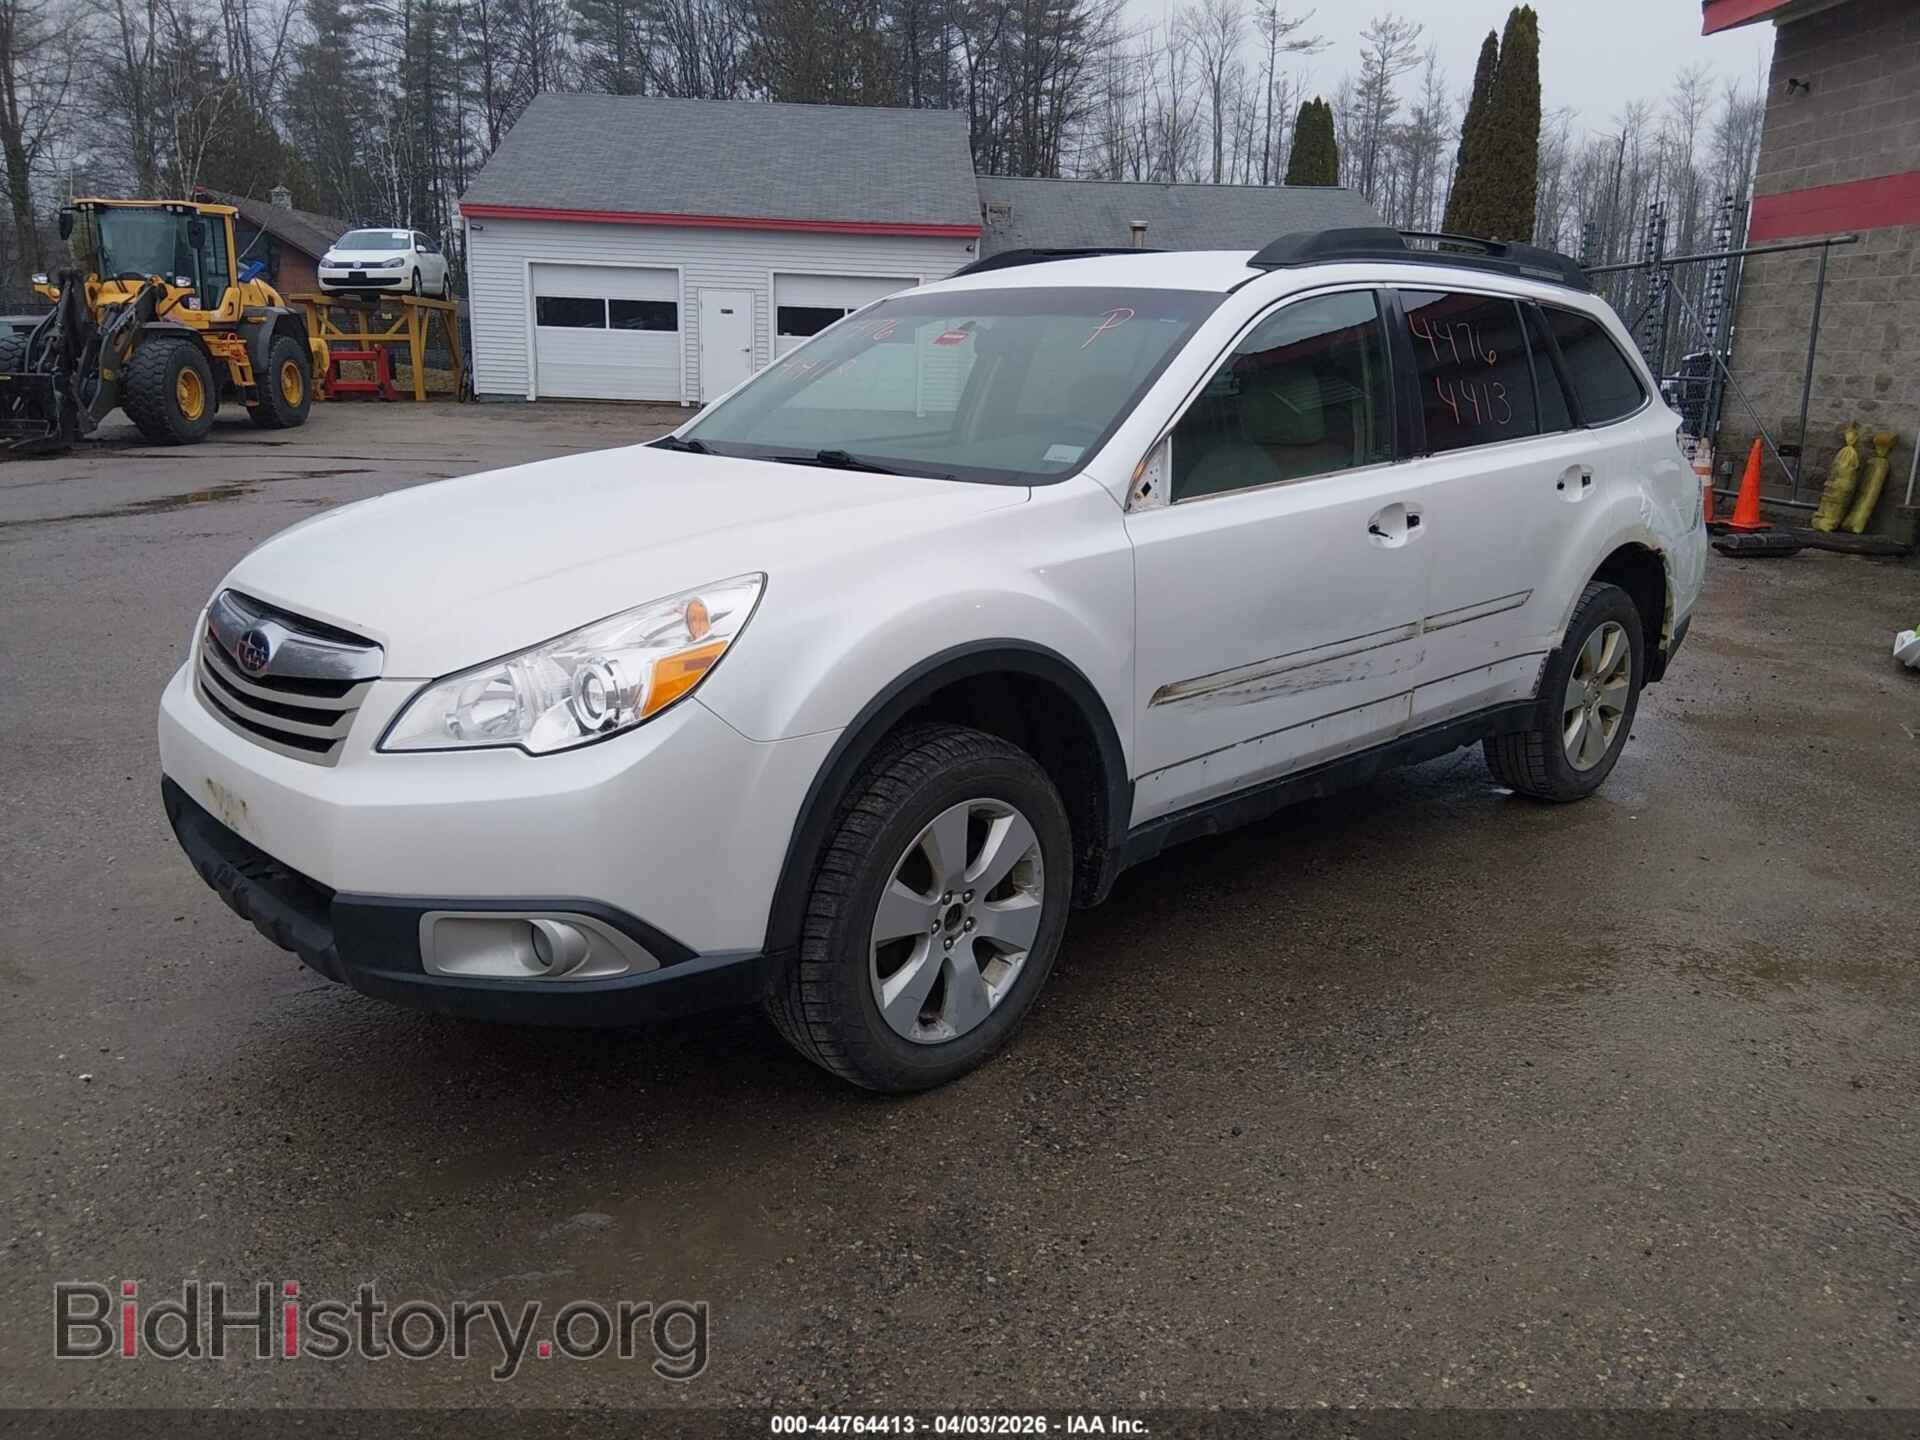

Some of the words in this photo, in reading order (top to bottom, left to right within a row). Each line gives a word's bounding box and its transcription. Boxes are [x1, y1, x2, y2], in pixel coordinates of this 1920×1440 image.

[1081, 307, 1136, 350] P
[1408, 313, 1497, 367] 4476
[1434, 376, 1512, 425] 4413
